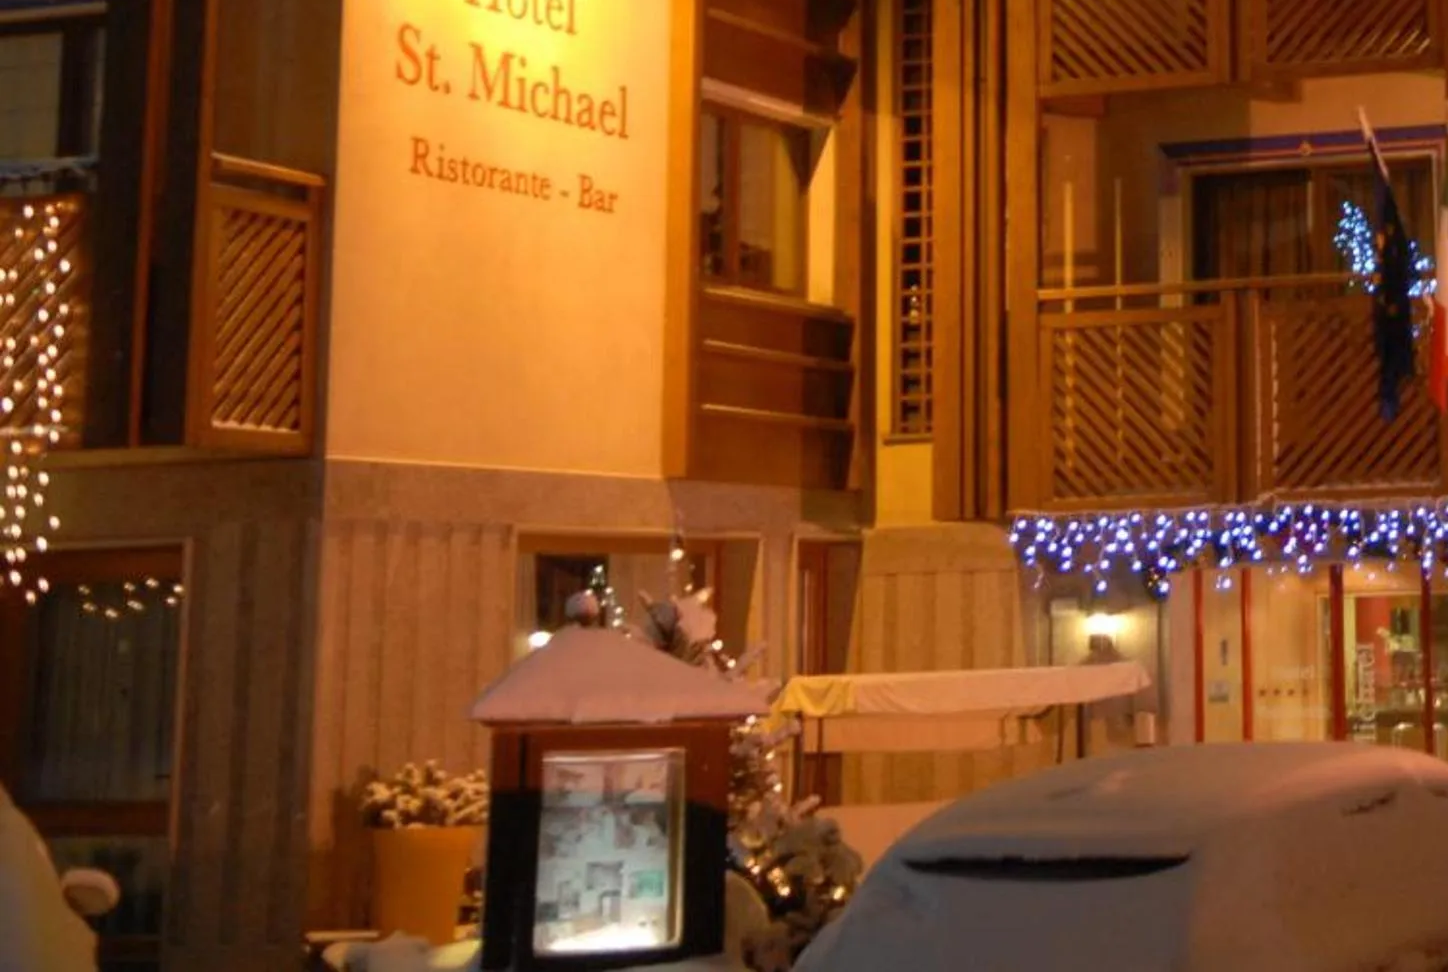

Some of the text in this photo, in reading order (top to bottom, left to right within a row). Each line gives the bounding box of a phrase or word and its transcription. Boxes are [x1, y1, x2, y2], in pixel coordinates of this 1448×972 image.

[394, 22, 630, 141] St. Michael
[408, 135, 553, 202] Ristorante
[576, 173, 619, 215] Bar
